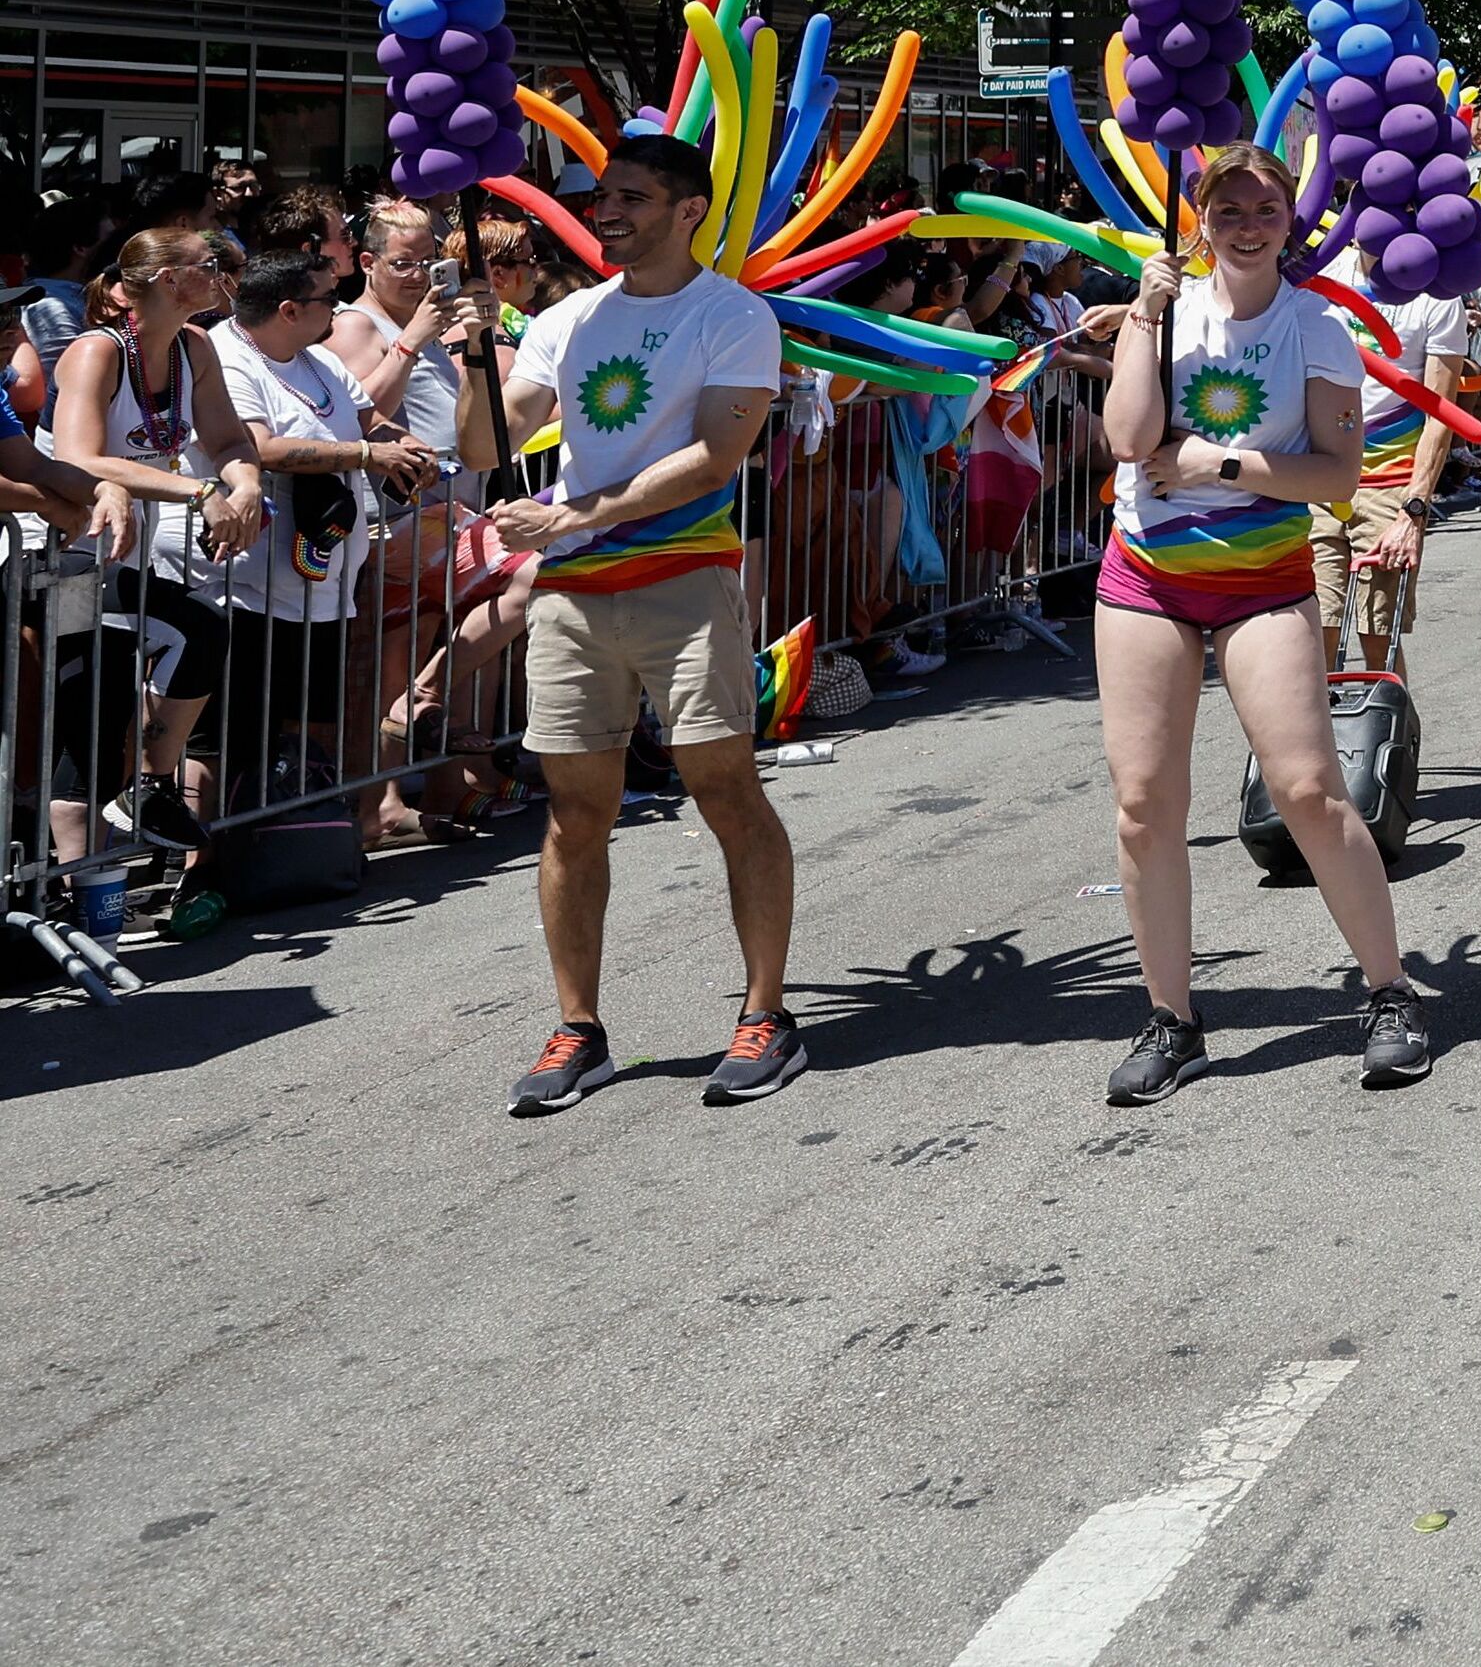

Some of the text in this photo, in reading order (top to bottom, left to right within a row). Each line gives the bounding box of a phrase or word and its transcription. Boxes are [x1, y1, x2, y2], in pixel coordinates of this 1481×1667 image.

[983, 82, 988, 92] 7
[990, 81, 1005, 91] DAY
[1006, 79, 1024, 91] PAID
[641, 327, 669, 352] bp
